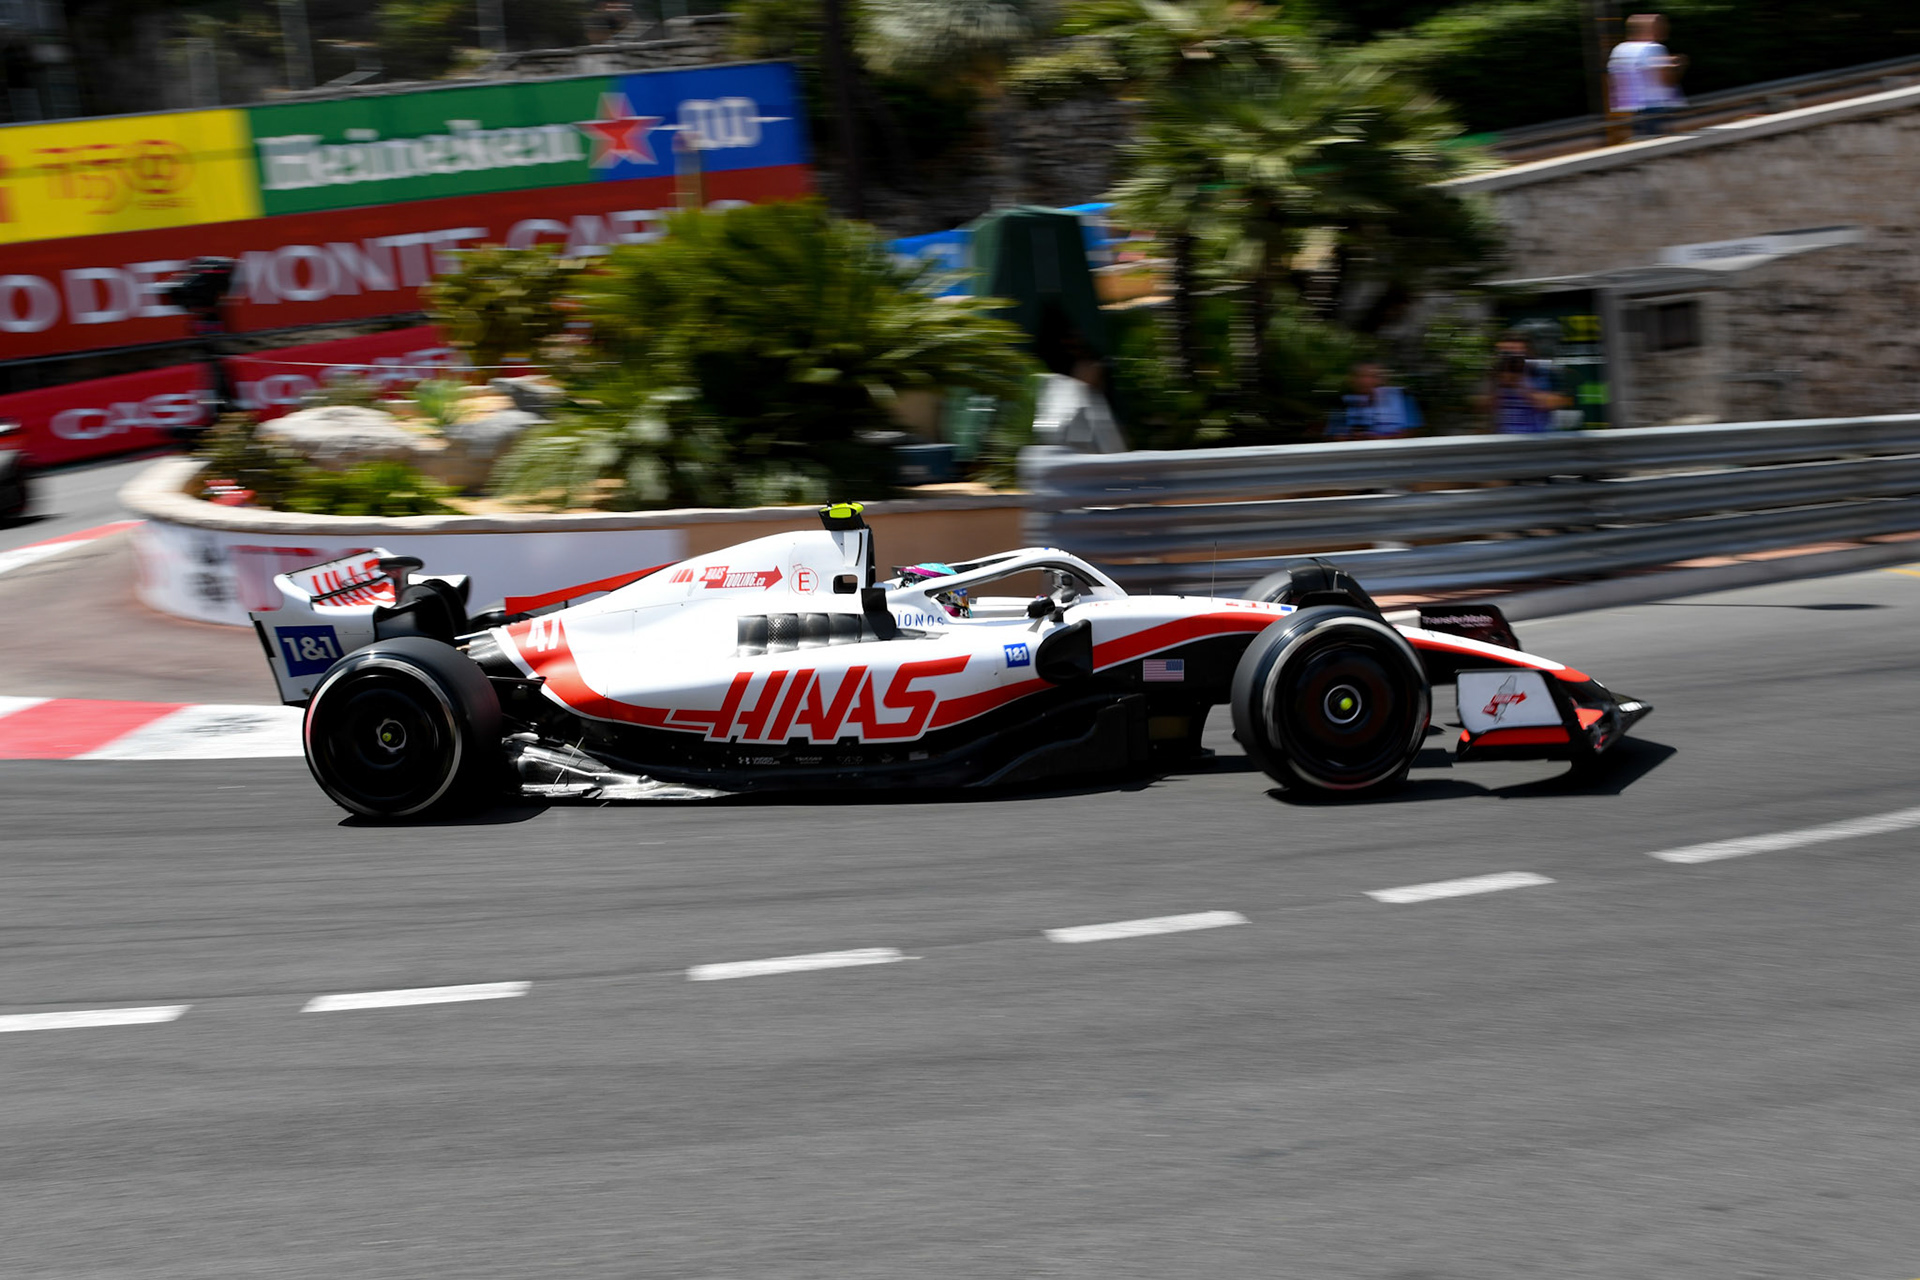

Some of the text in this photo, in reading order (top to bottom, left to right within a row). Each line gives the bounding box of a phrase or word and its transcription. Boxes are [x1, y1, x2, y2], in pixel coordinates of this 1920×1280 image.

[256, 119, 586, 190] Heineken
[62, 259, 189, 324] DE
[230, 227, 489, 304] MONTE
[798, 571, 811, 592] E
[525, 618, 560, 652] 47
[897, 613, 945, 628] IONOS
[282, 636, 341, 663] 1&1
[1005, 646, 1028, 662] 1&1
[671, 654, 972, 741] HAAS
